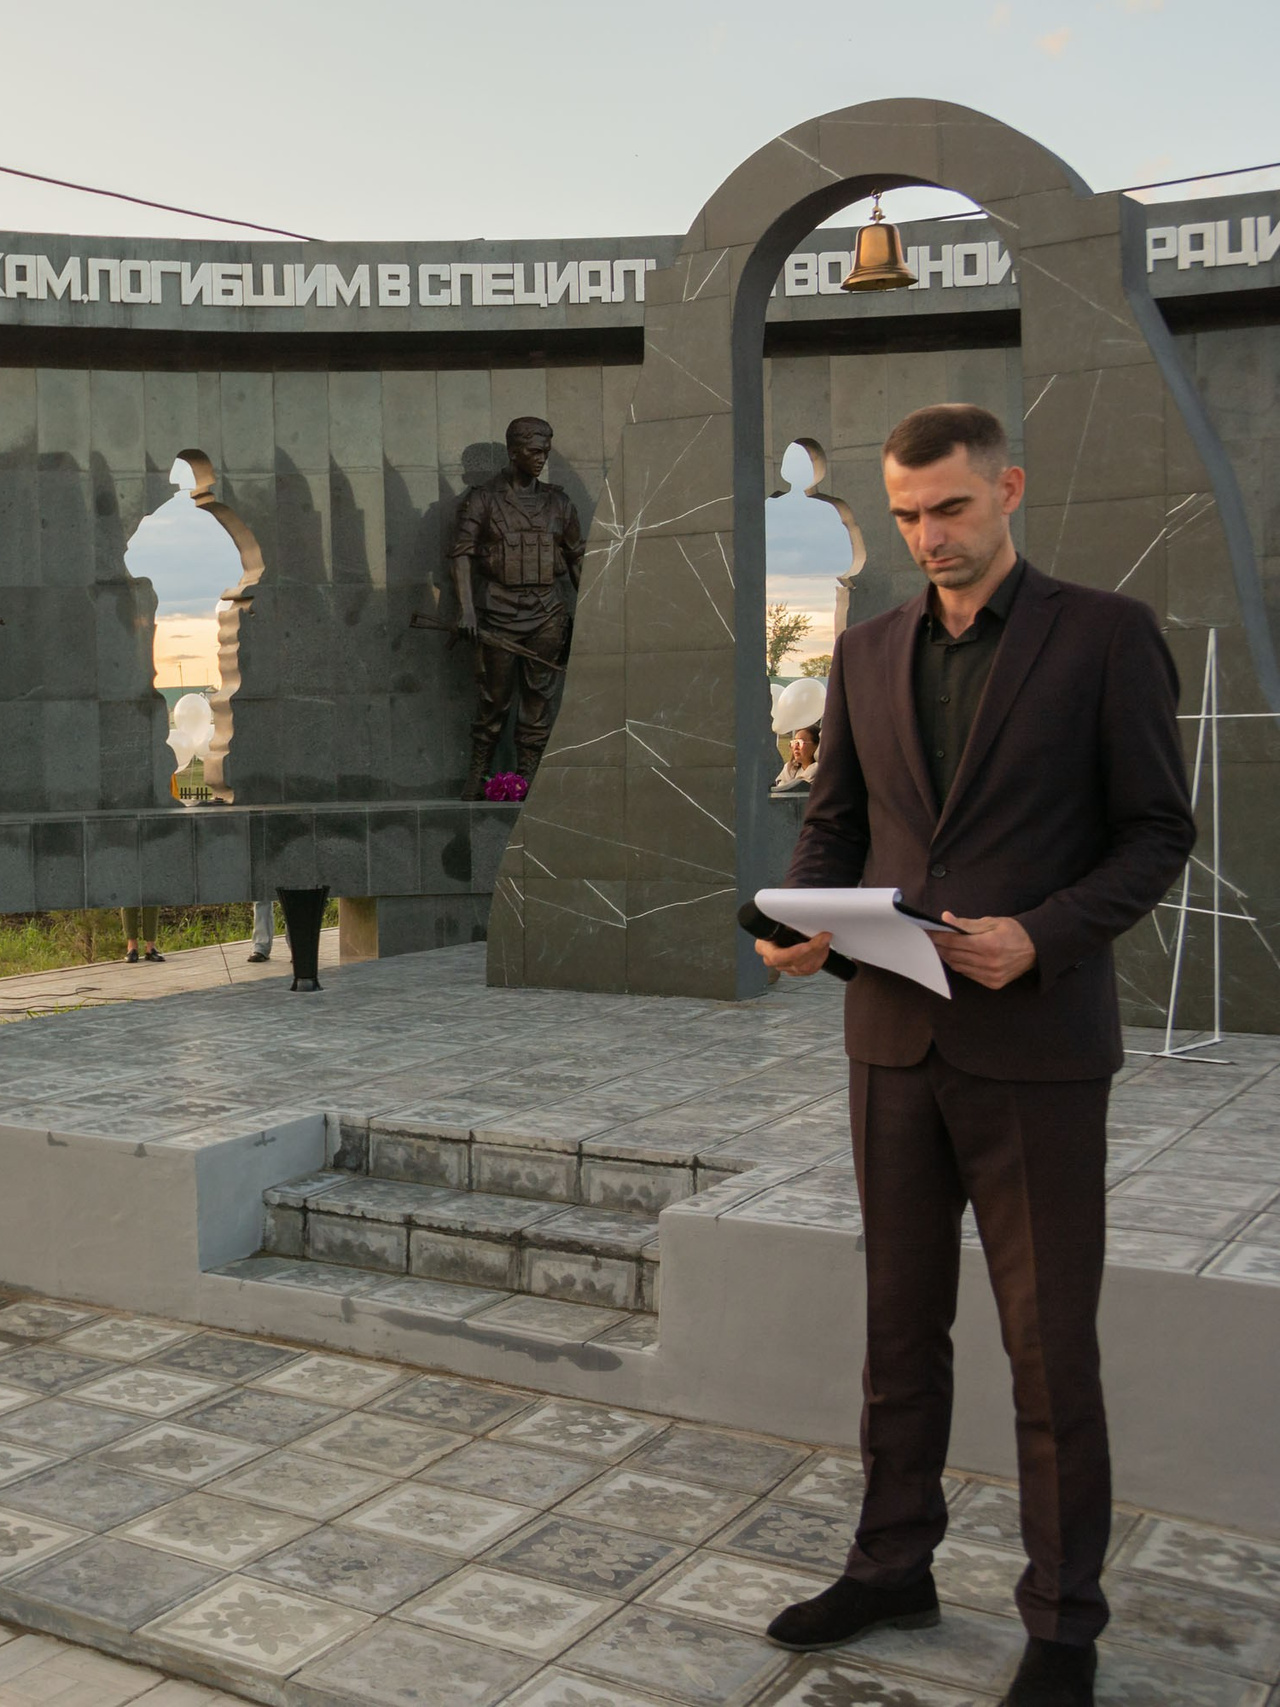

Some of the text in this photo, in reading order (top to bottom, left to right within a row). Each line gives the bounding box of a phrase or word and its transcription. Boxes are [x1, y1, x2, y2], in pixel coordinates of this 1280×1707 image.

[88, 257, 370, 307] ПОГИБШИМ
[378, 264, 411, 307] В
[418, 258, 657, 308] СПЕЦИАЛ
